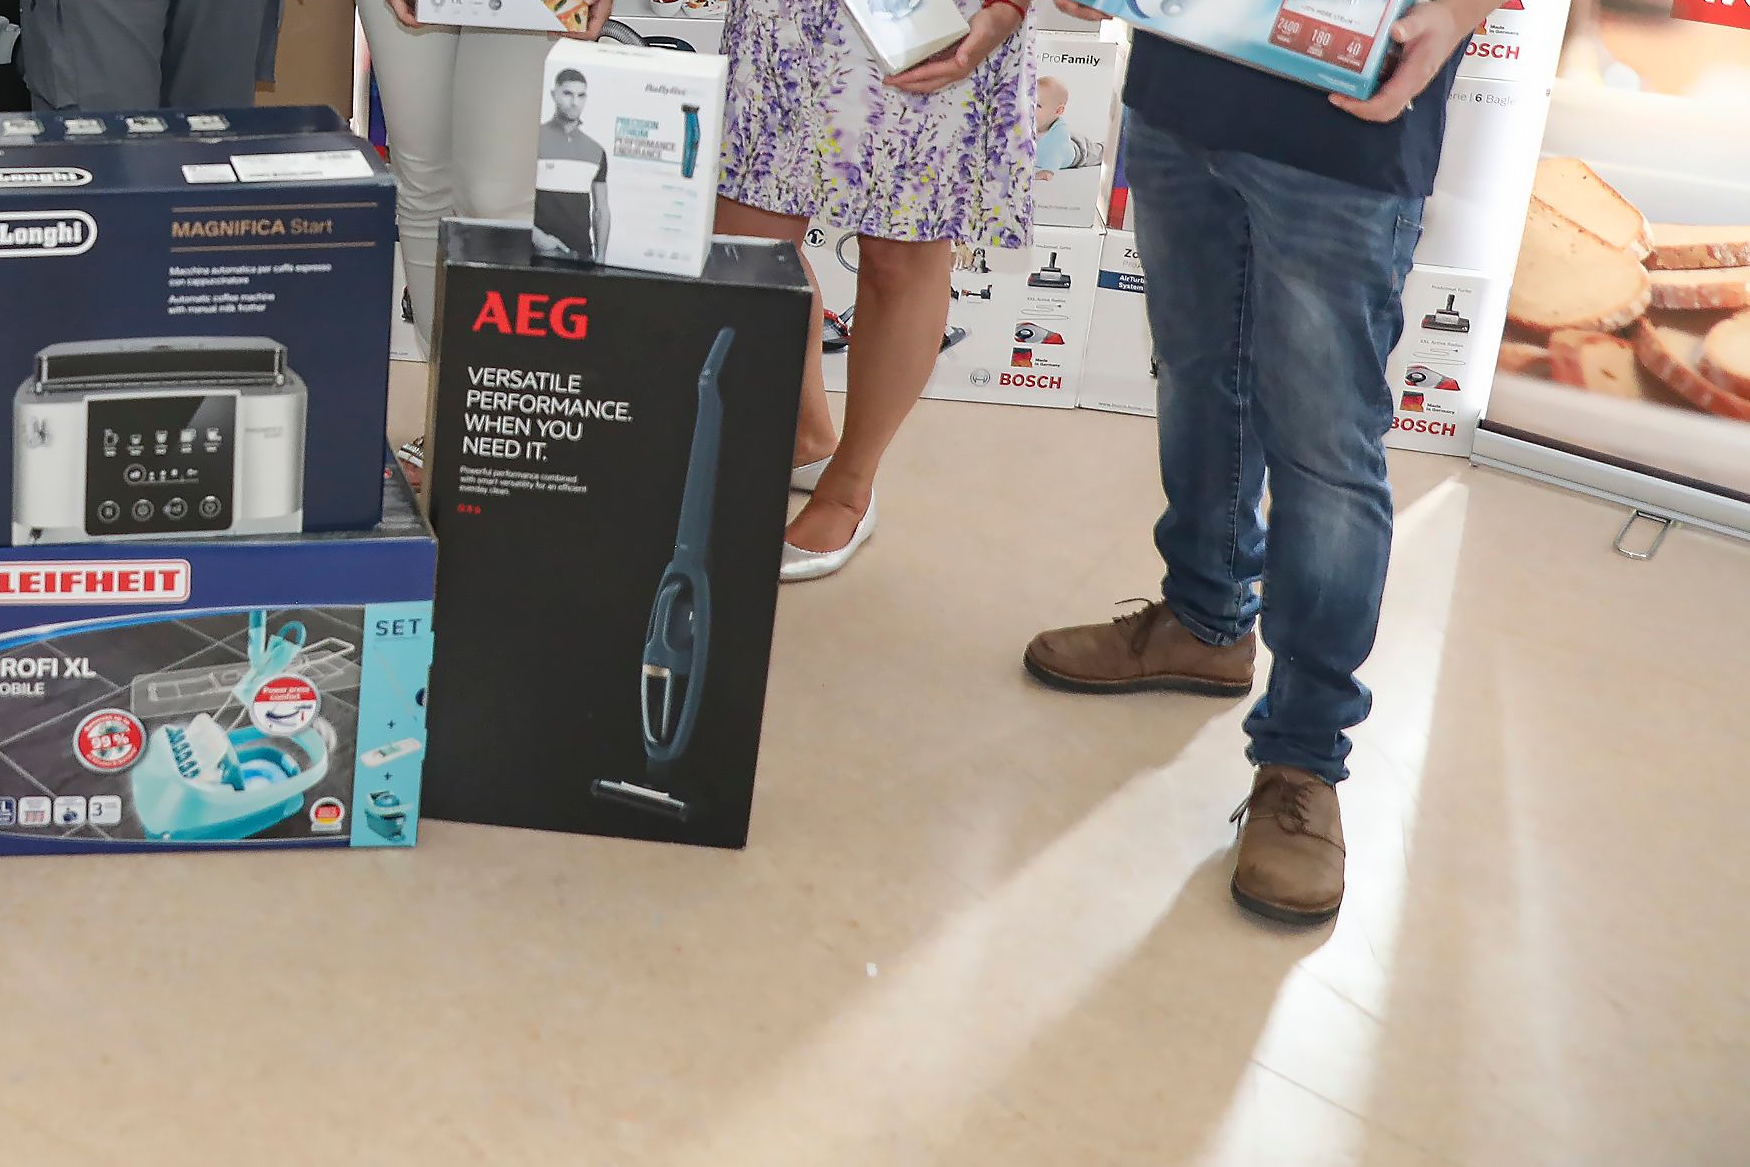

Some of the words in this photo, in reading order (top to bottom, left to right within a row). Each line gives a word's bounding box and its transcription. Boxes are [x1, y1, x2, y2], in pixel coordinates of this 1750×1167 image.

[1311, 29, 1330, 46] 180
[1346, 41, 1362, 55] 40
[1464, 42, 1520, 60] OSCH
[1475, 93, 1483, 102] 6
[171, 217, 285, 239] MAGNIFICA
[290, 217, 333, 236] Start
[1118, 281, 1144, 291] System
[471, 290, 589, 340] AEG
[467, 366, 582, 395] VERSATILE
[999, 372, 1062, 390] BOSCH
[466, 389, 633, 422] PERFORMANCE.
[464, 412, 532, 437] WHEN
[536, 419, 584, 442] YOU
[462, 435, 522, 460] NEED
[525, 441, 548, 462] IT.
[374, 617, 423, 636] SET
[65, 657, 97, 678] XL
